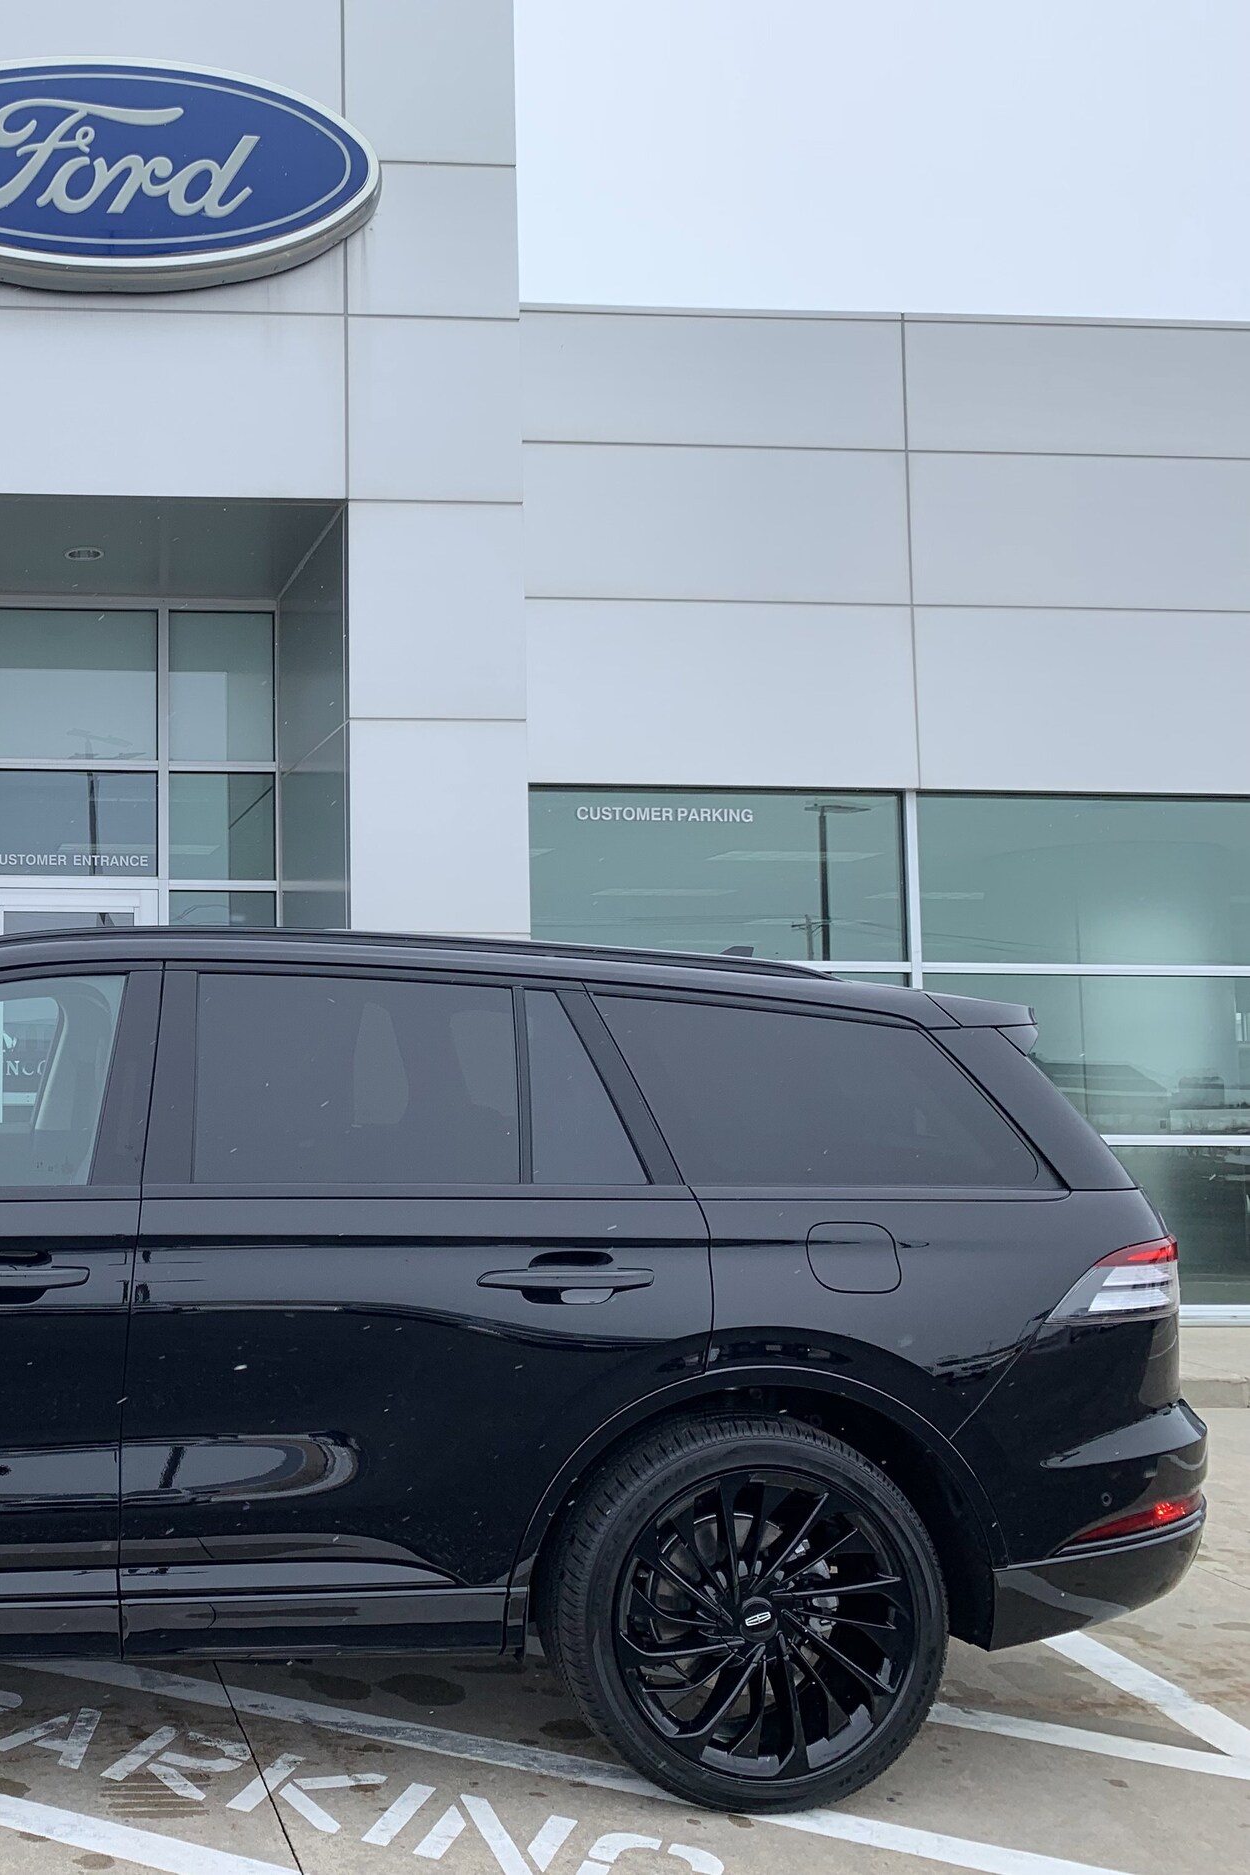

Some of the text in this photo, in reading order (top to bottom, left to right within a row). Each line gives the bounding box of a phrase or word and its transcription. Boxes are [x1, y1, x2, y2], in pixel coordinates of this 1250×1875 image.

[576, 806, 754, 822] CUSTOMER PARKING
[73, 855, 149, 867] ENTRANCE
